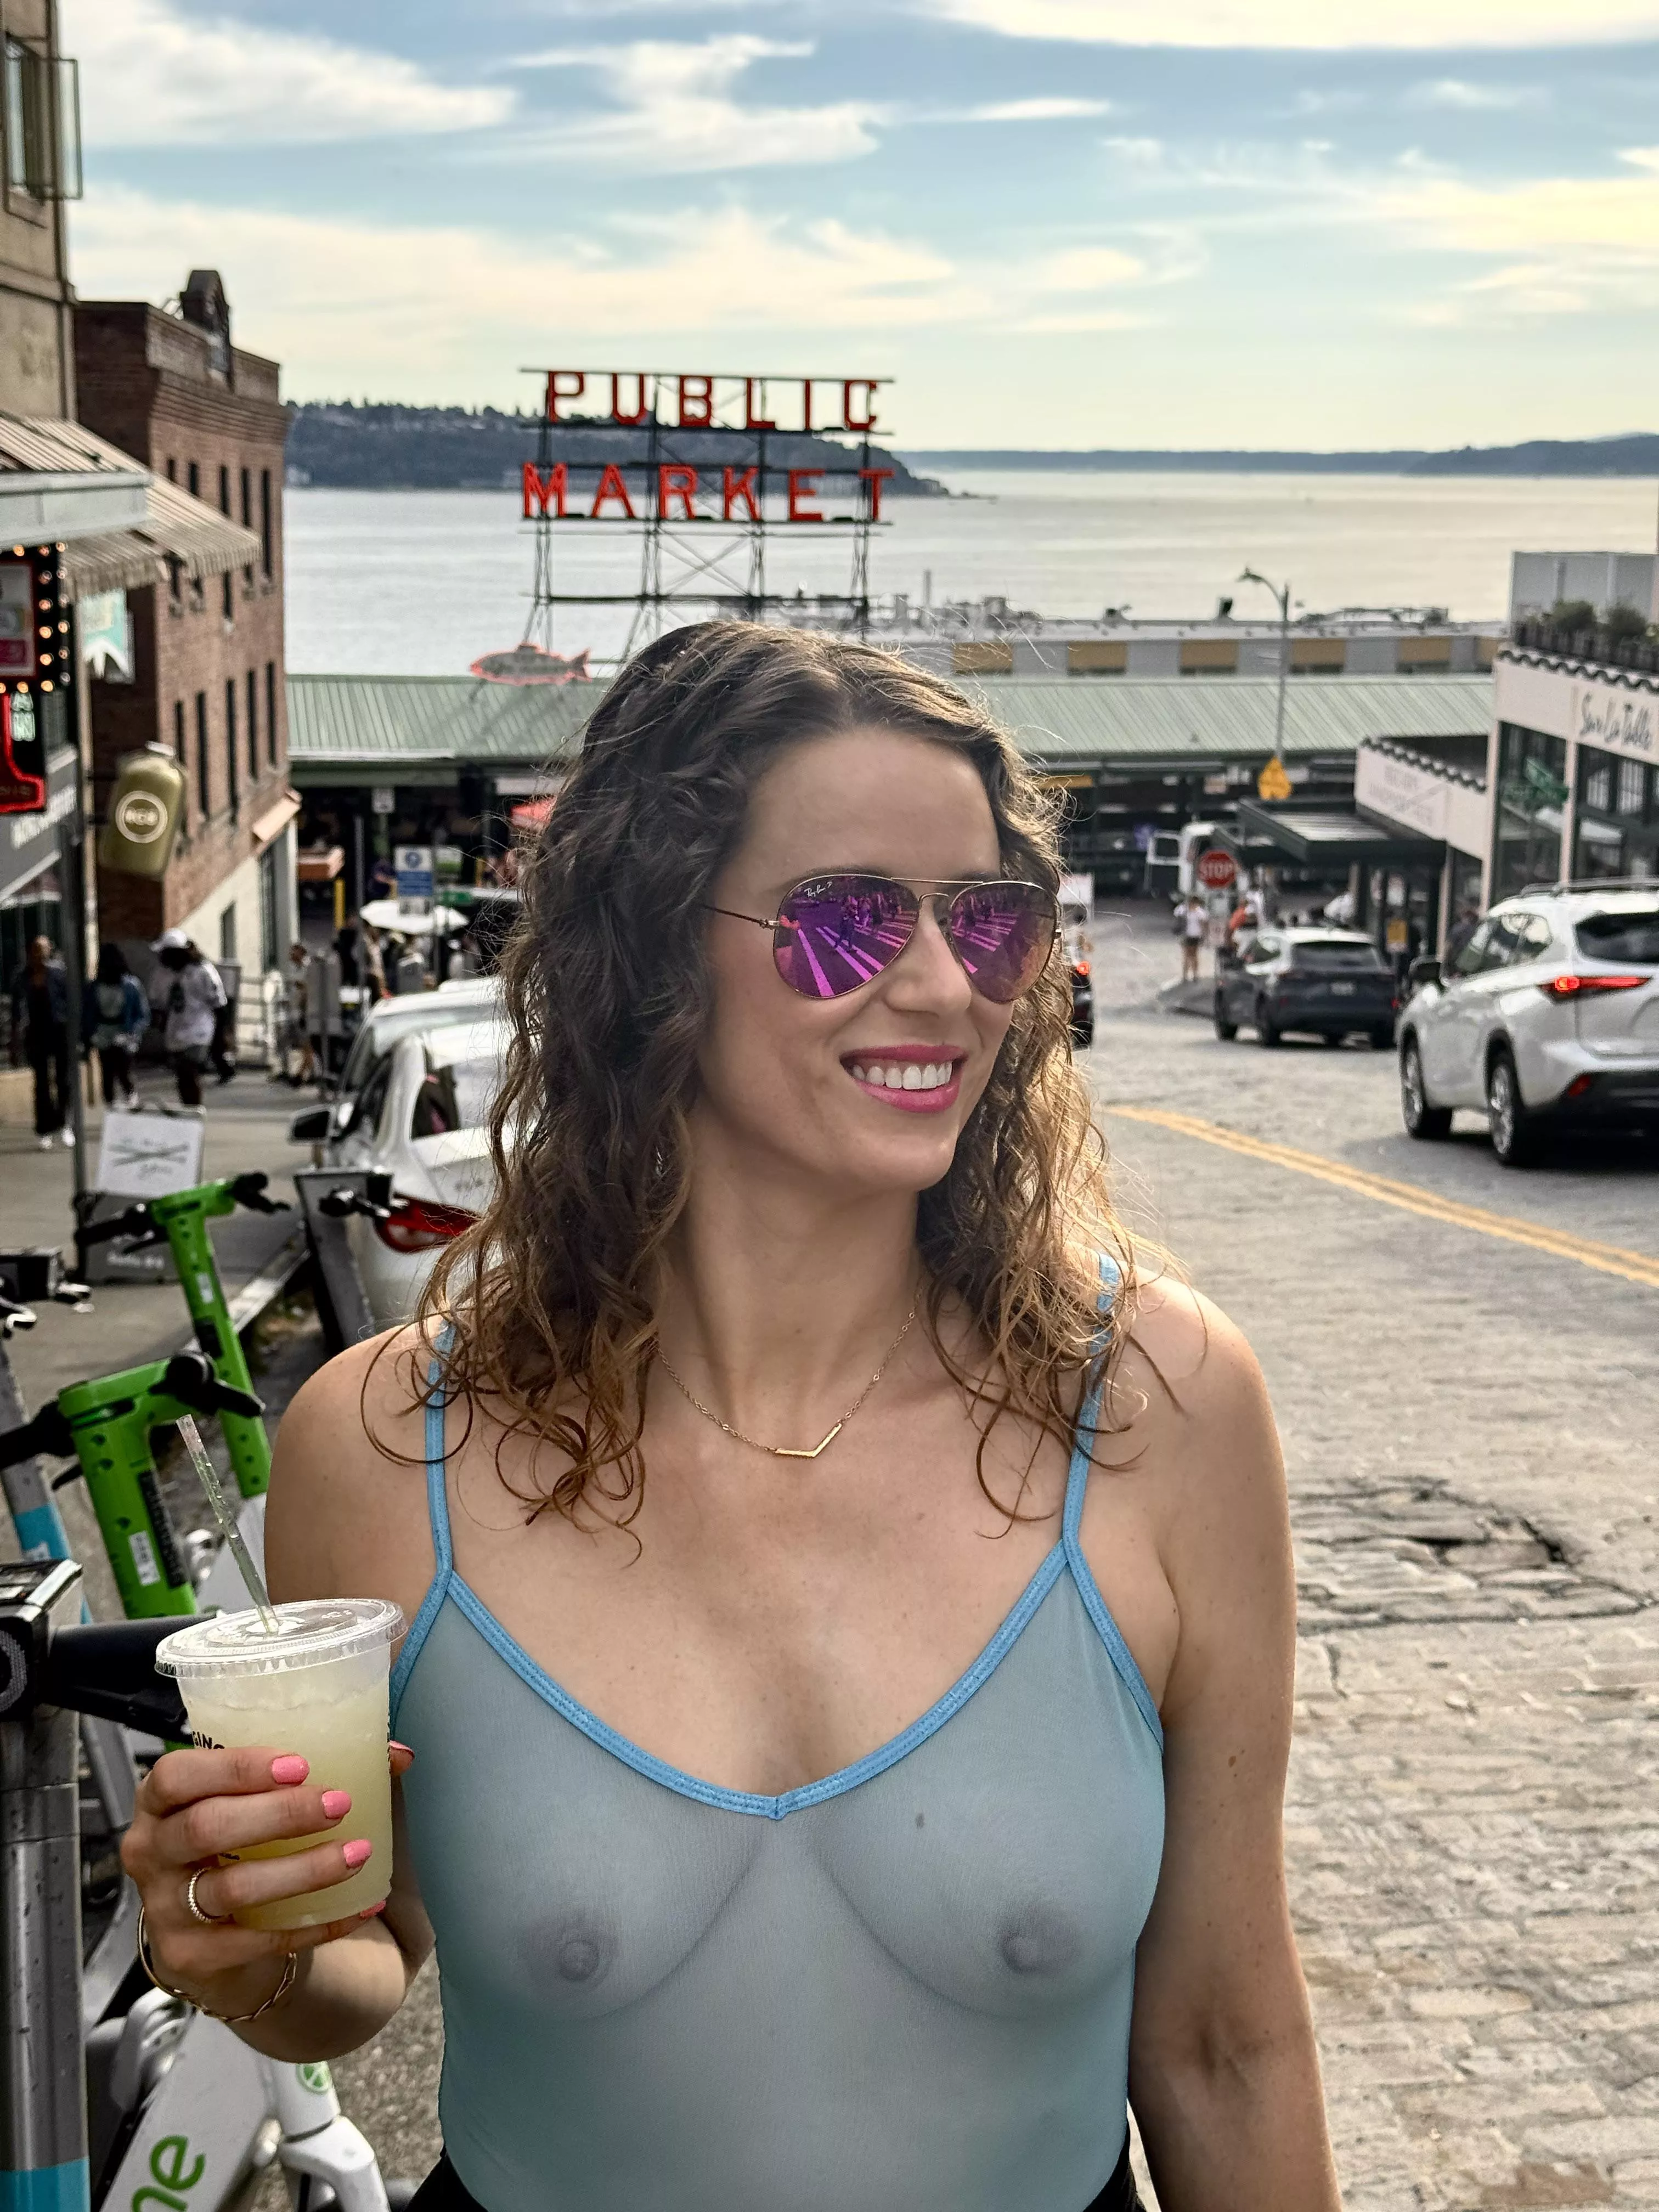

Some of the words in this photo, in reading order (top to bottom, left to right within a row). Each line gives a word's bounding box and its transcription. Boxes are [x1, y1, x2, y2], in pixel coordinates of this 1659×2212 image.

[548, 371, 877, 431] PUBLIC
[523, 461, 894, 522] MARKET
[1199, 861, 1233, 879] STOP
